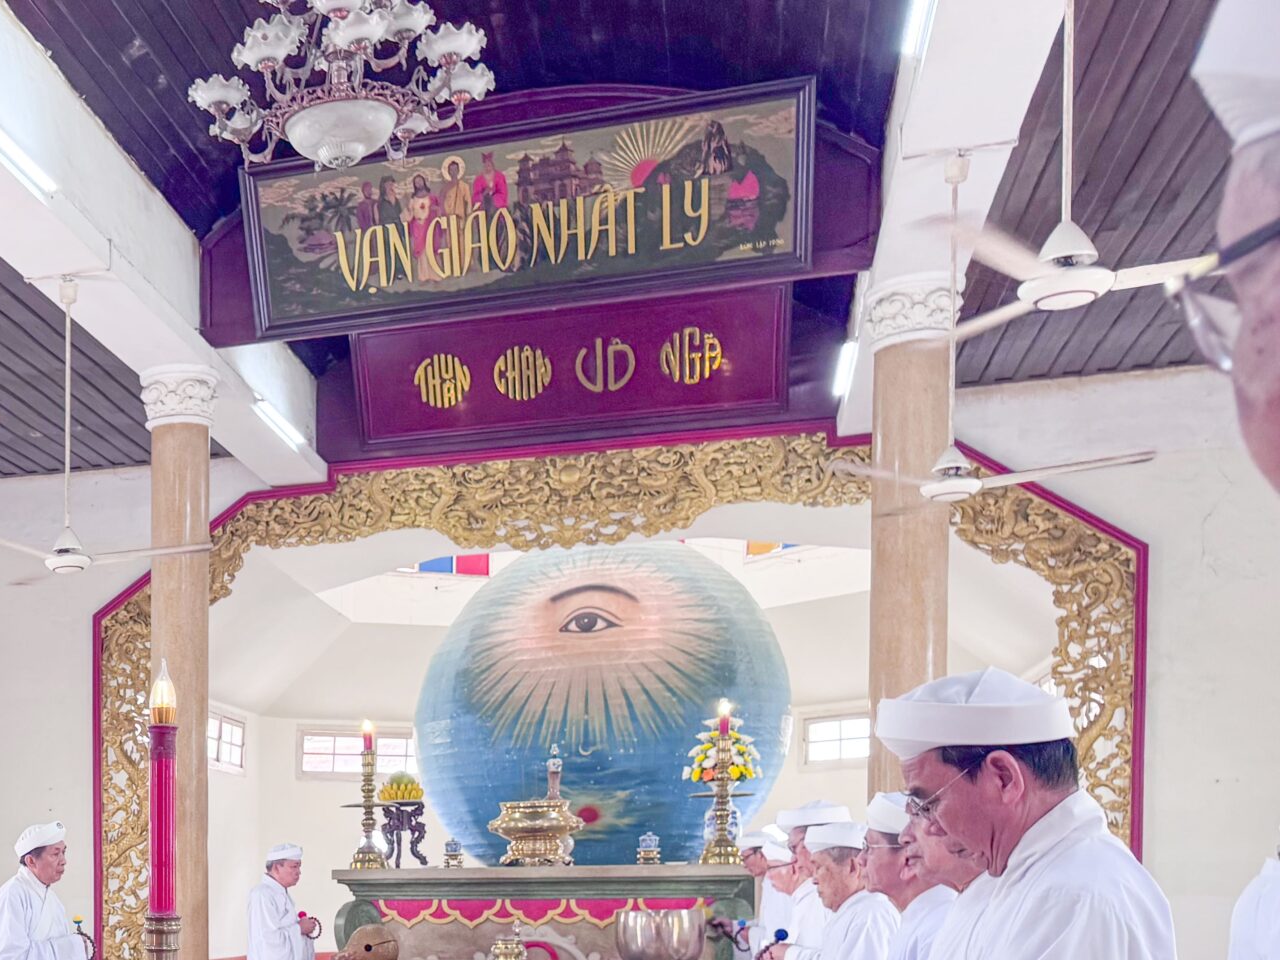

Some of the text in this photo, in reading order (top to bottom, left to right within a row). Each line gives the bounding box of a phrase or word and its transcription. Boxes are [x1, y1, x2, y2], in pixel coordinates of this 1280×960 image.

[333, 221, 413, 293] VẠN
[425, 201, 517, 279] GIÁO
[493, 344, 552, 401] CHÂN
